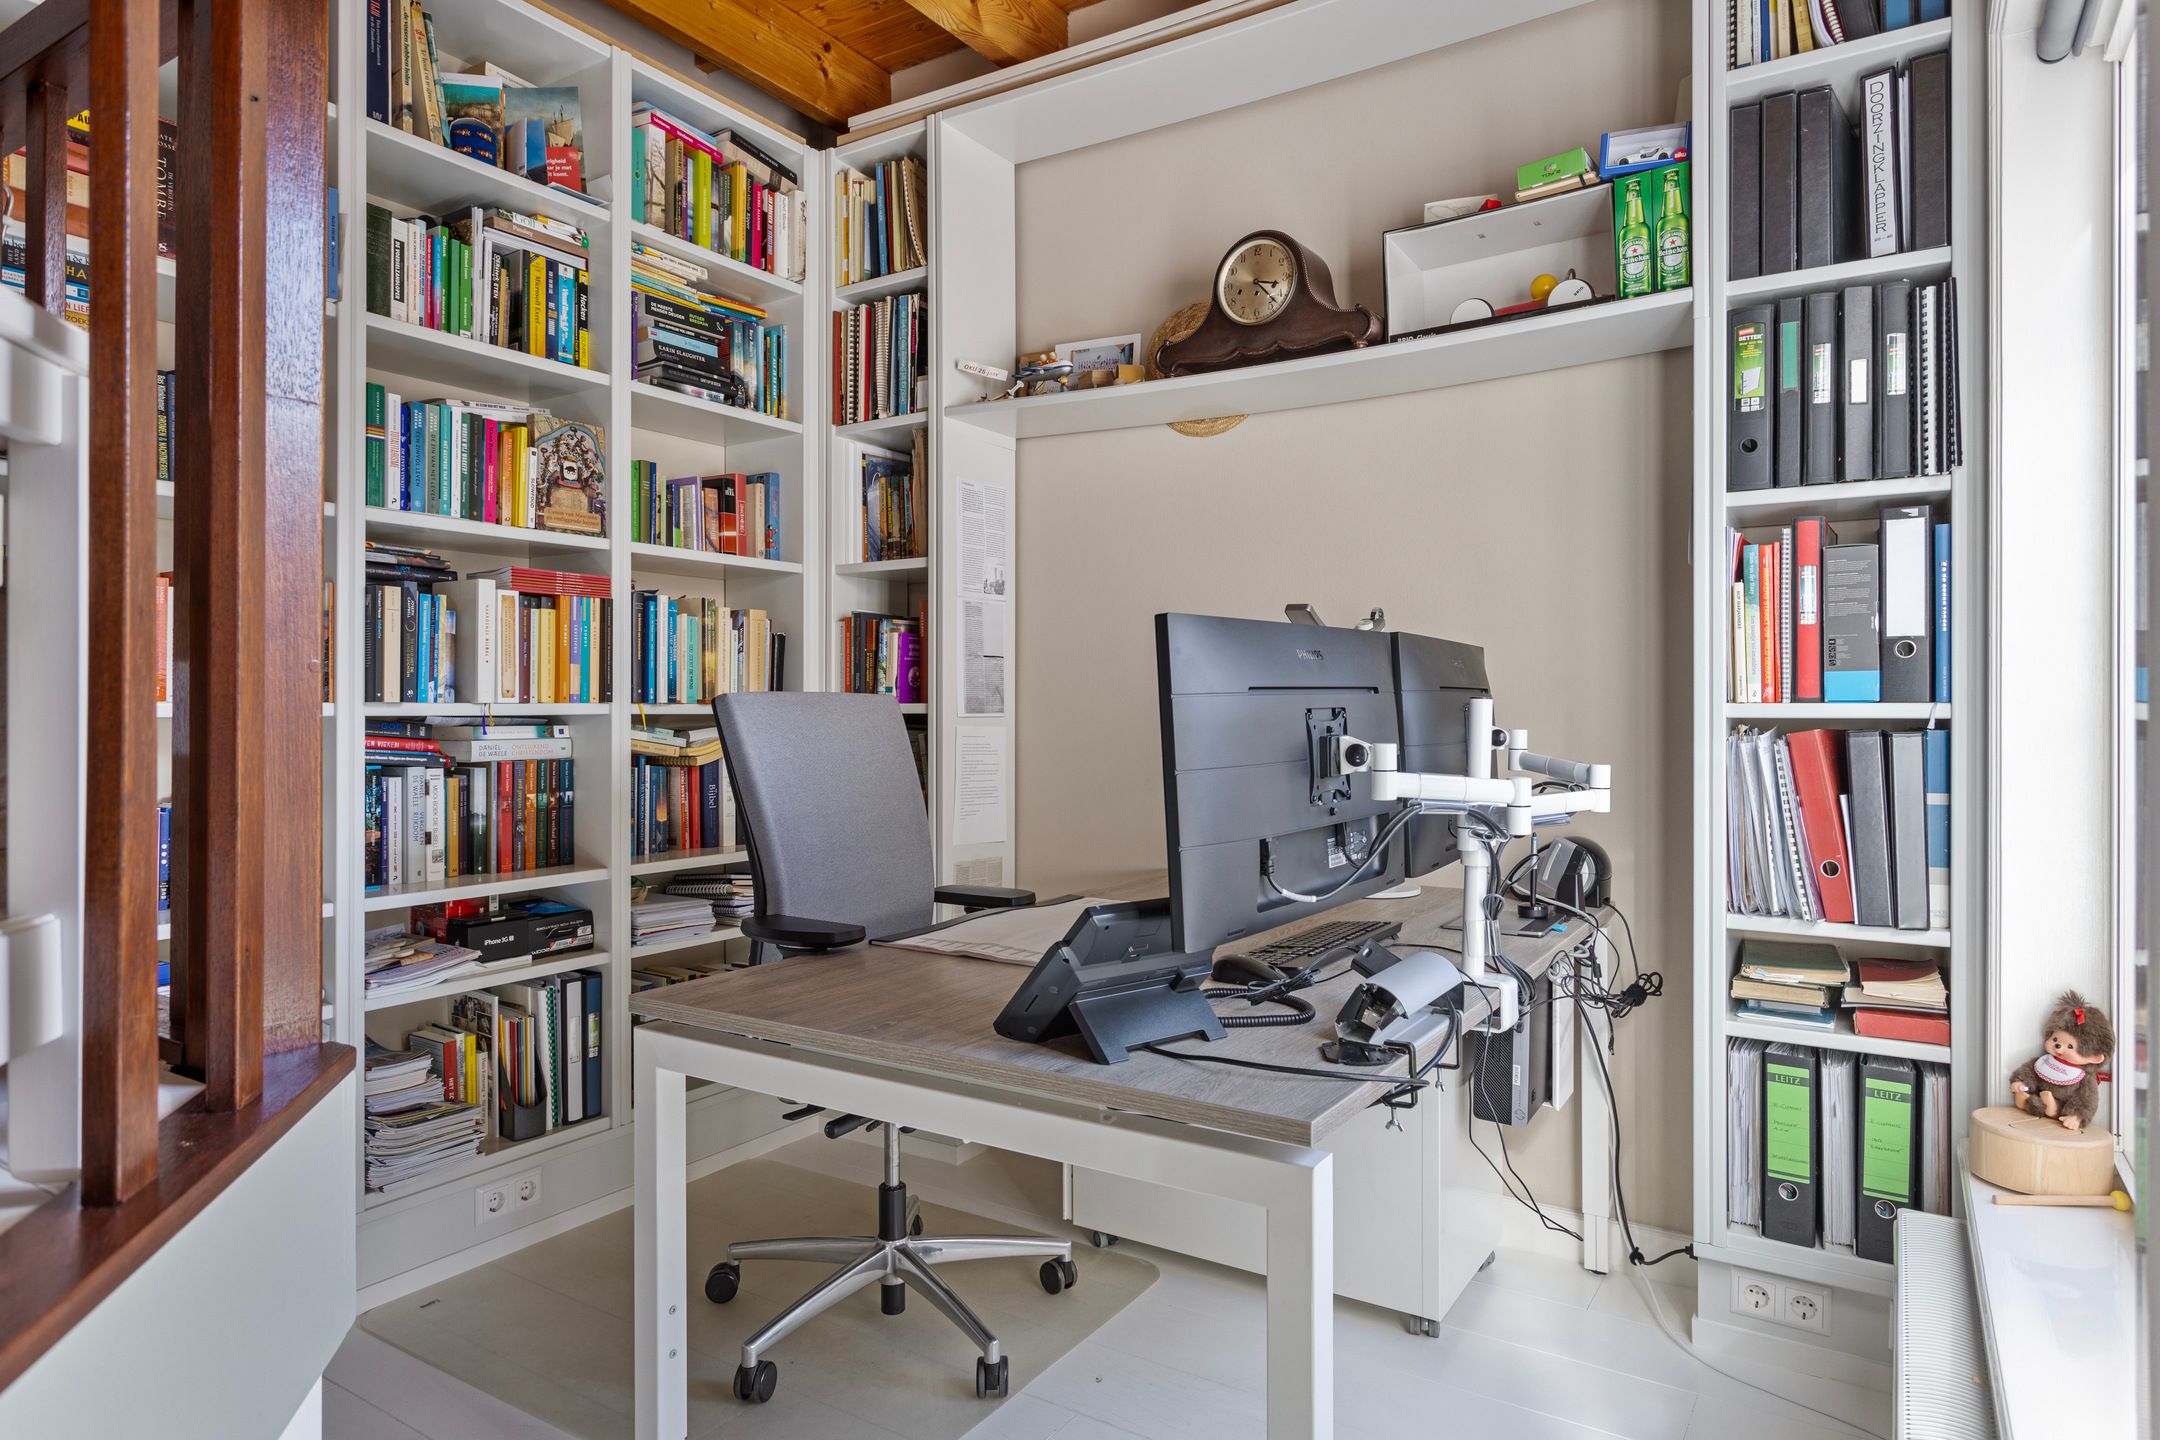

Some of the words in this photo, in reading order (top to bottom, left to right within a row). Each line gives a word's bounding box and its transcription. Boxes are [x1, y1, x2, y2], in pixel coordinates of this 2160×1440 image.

[403, 21, 411, 42] vossen
[1869, 81, 1887, 233] DOORZINGKLAPPER
[658, 344, 674, 354] KARIN
[676, 348, 706, 362] SLAUGHTER
[380, 722, 404, 731] GOD
[412, 775, 418, 784] DE
[707, 784, 717, 808] Bijbel
[484, 937, 501, 946] iPhone
[1775, 1074, 1801, 1085] LEITZ
[1874, 1089, 1903, 1102] LEITZ
